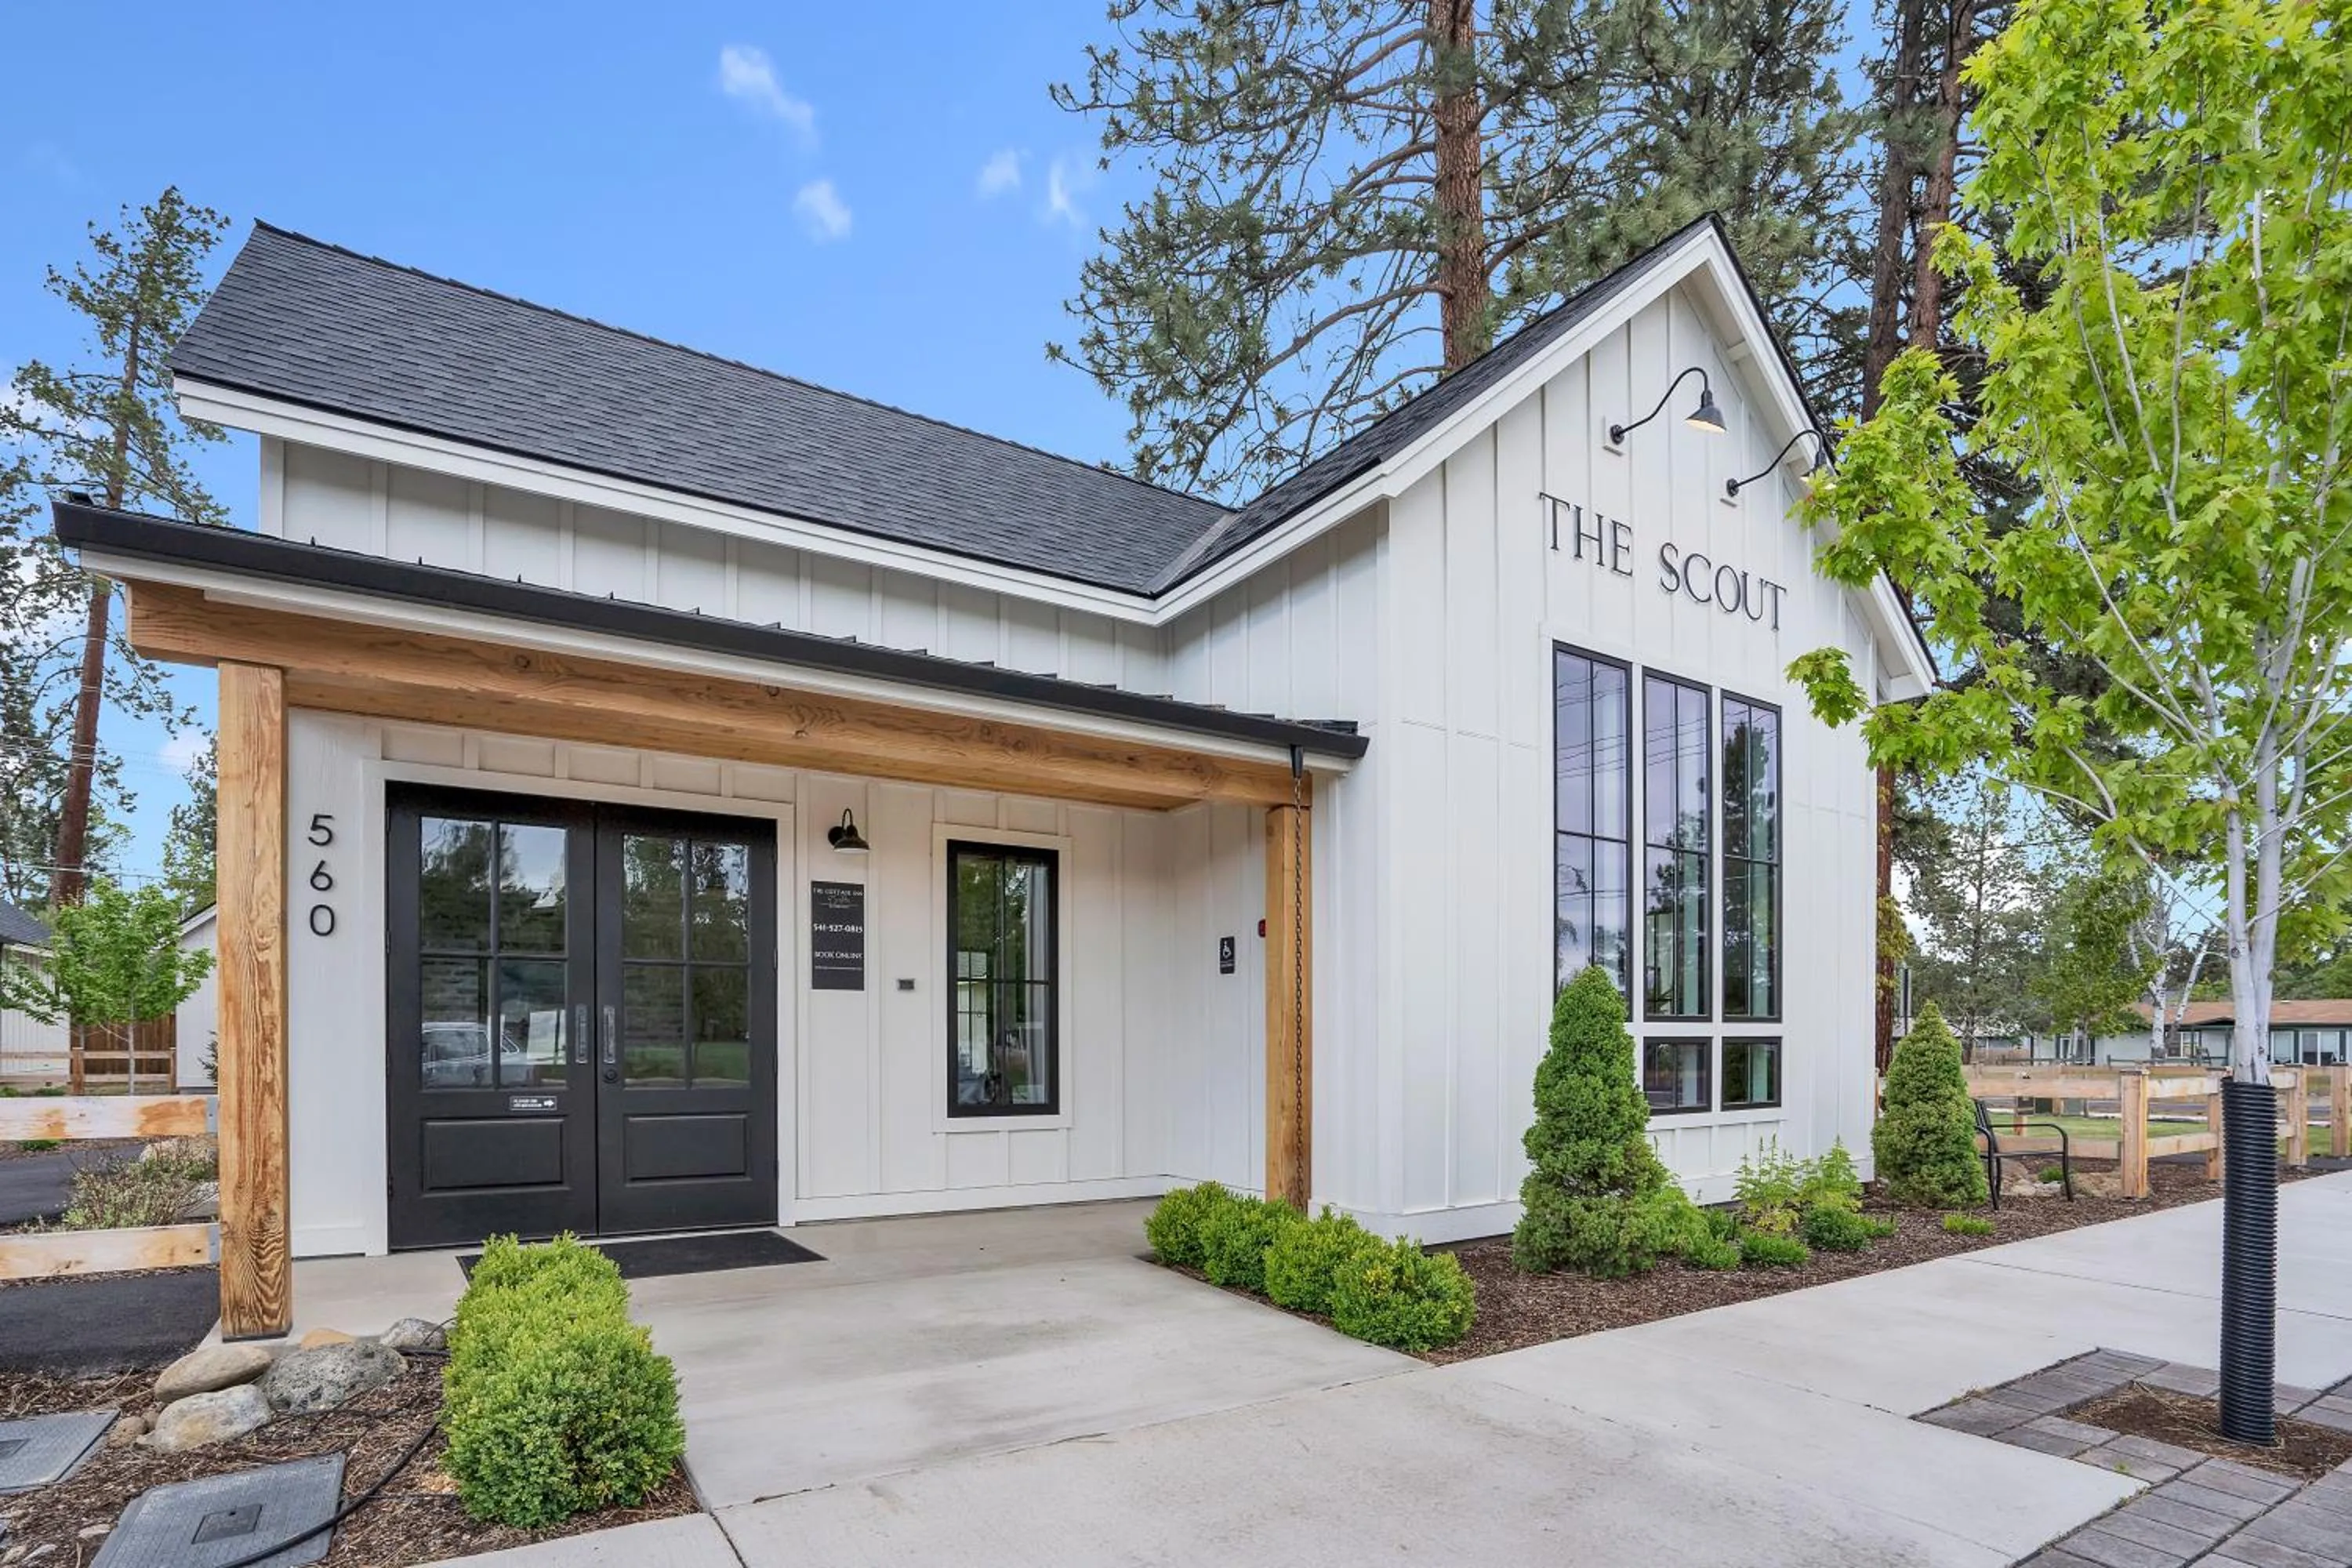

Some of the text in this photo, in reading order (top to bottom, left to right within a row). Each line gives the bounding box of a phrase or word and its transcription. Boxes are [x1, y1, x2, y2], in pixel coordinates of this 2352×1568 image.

[1539, 492, 1787, 631] THE SCOUT
[308, 814, 335, 936] 560
